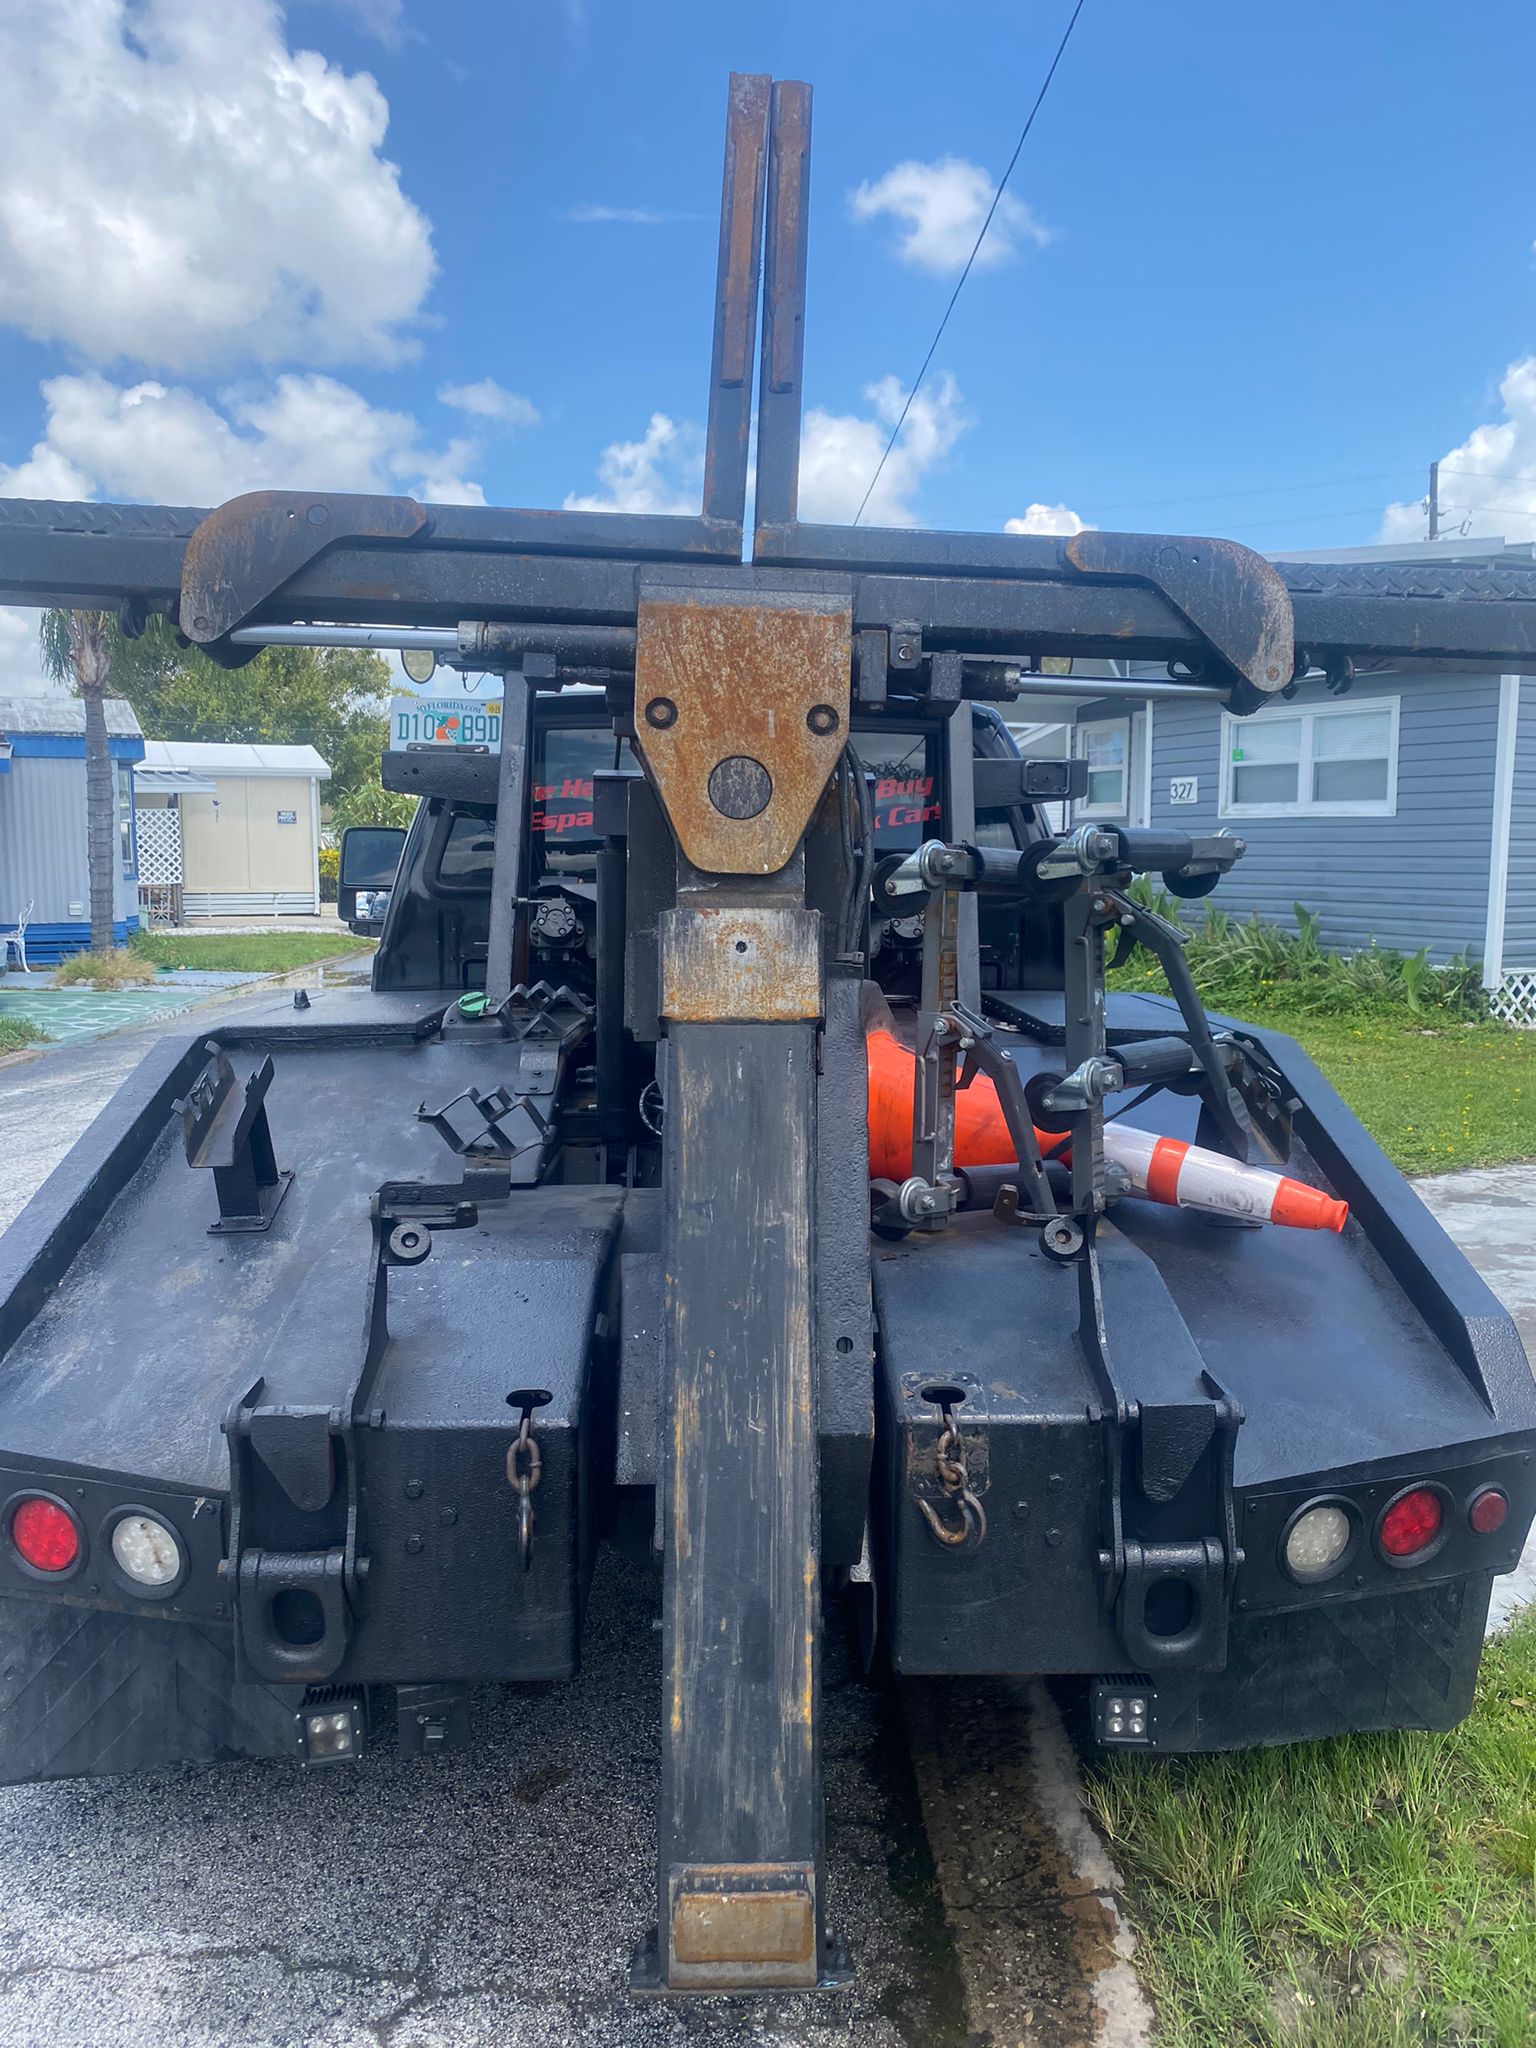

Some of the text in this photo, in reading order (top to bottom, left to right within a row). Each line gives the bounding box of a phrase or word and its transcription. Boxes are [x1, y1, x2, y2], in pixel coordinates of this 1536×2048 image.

[416, 701, 482, 714] MYFLORIDA.COM
[397, 713, 500, 743] D10 89D
[876, 777, 934, 799] Buy
[1171, 782, 1193, 799] 327
[888, 805, 942, 827] Cars
